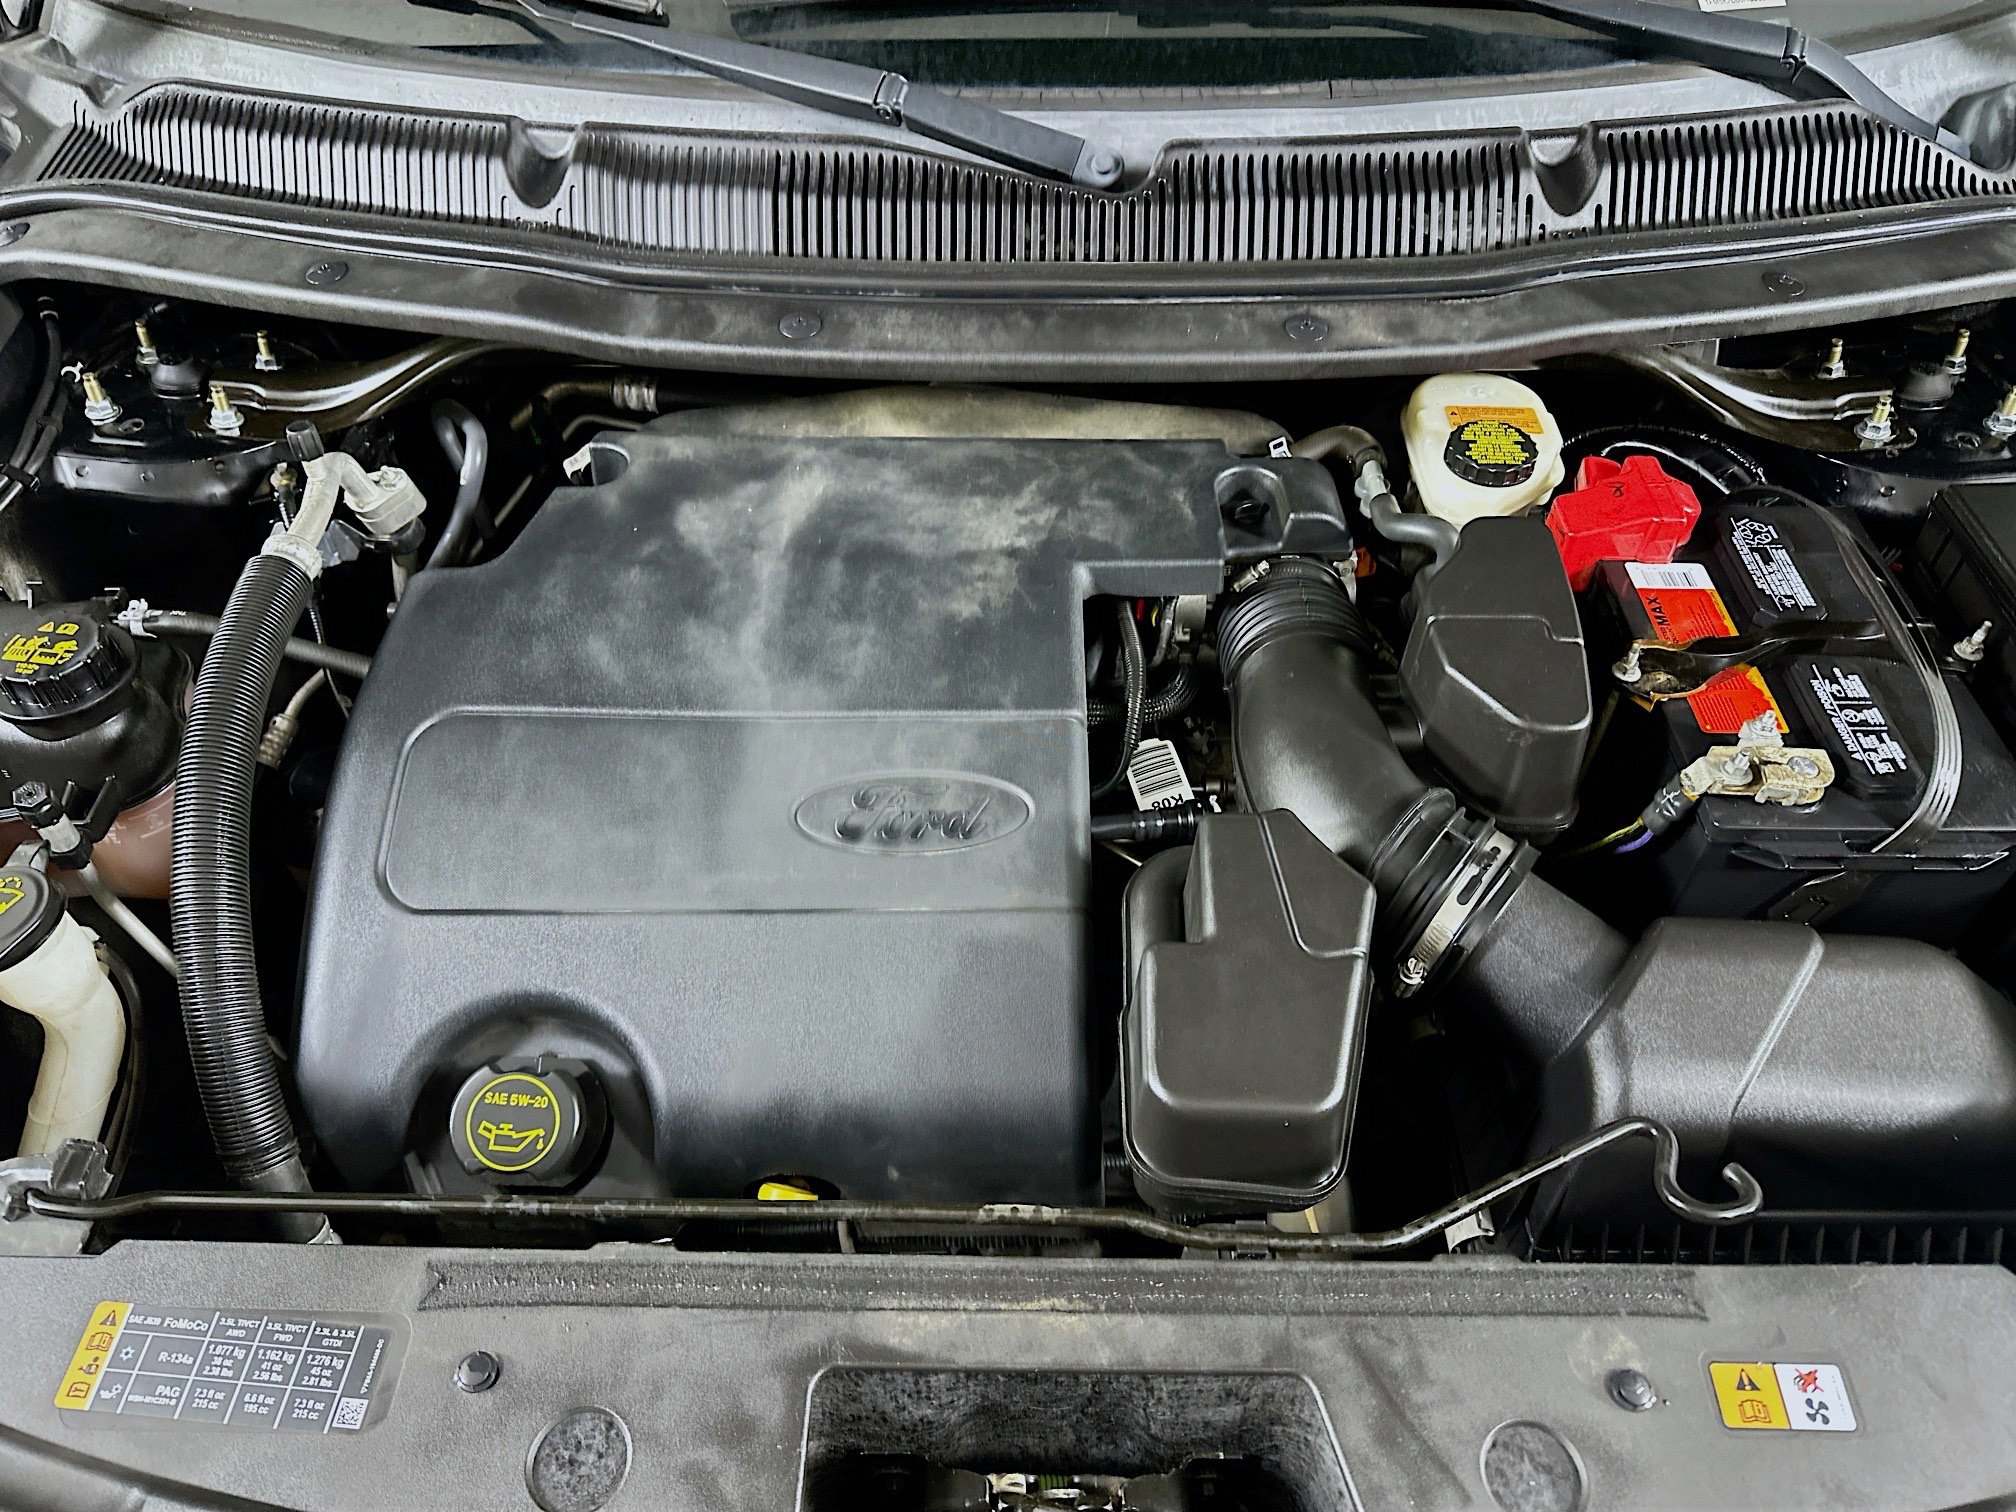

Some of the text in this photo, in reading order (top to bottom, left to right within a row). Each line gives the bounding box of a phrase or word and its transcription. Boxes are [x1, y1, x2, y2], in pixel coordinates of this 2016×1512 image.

[1645, 596, 1671, 626] MAX
[1810, 679, 1834, 709] POISON
[1831, 716, 1858, 751] DANGER
[834, 785, 991, 840] Ford
[484, 1092, 549, 1109] SAE 5W-20
[128, 1314, 145, 1324] SAE
[163, 1316, 209, 1331] FoMoCo
[219, 1317, 236, 1326] 3.5L
[266, 1322, 283, 1332] 3.5L
[225, 1328, 247, 1337] AWD
[273, 1333, 293, 1342] FWD
[314, 1327, 331, 1336] 2.3L
[339, 1330, 356, 1338] 3.5L
[158, 1351, 194, 1365] R-134a
[208, 1344, 247, 1360] 1.077 kg
[258, 1349, 295, 1365] 1.162 kg
[223, 1359, 233, 1367] oz
[260, 1361, 283, 1372] 41 oz
[306, 1354, 345, 1370] 1.276 kg
[220, 1367, 234, 1378] lbs
[270, 1372, 283, 1383] lbs
[321, 1369, 332, 1377] oz
[319, 1377, 333, 1388] lbs
[155, 1384, 181, 1398] PAG
[194, 1387, 208, 1399] 7.3
[214, 1391, 226, 1400] oz
[191, 1398, 219, 1410] 215 cc
[264, 1396, 275, 1405] oz
[294, 1398, 307, 1409] 7.3
[314, 1401, 326, 1411] oz
[257, 1406, 269, 1415] cc
[291, 1408, 320, 1420] 215 cc
